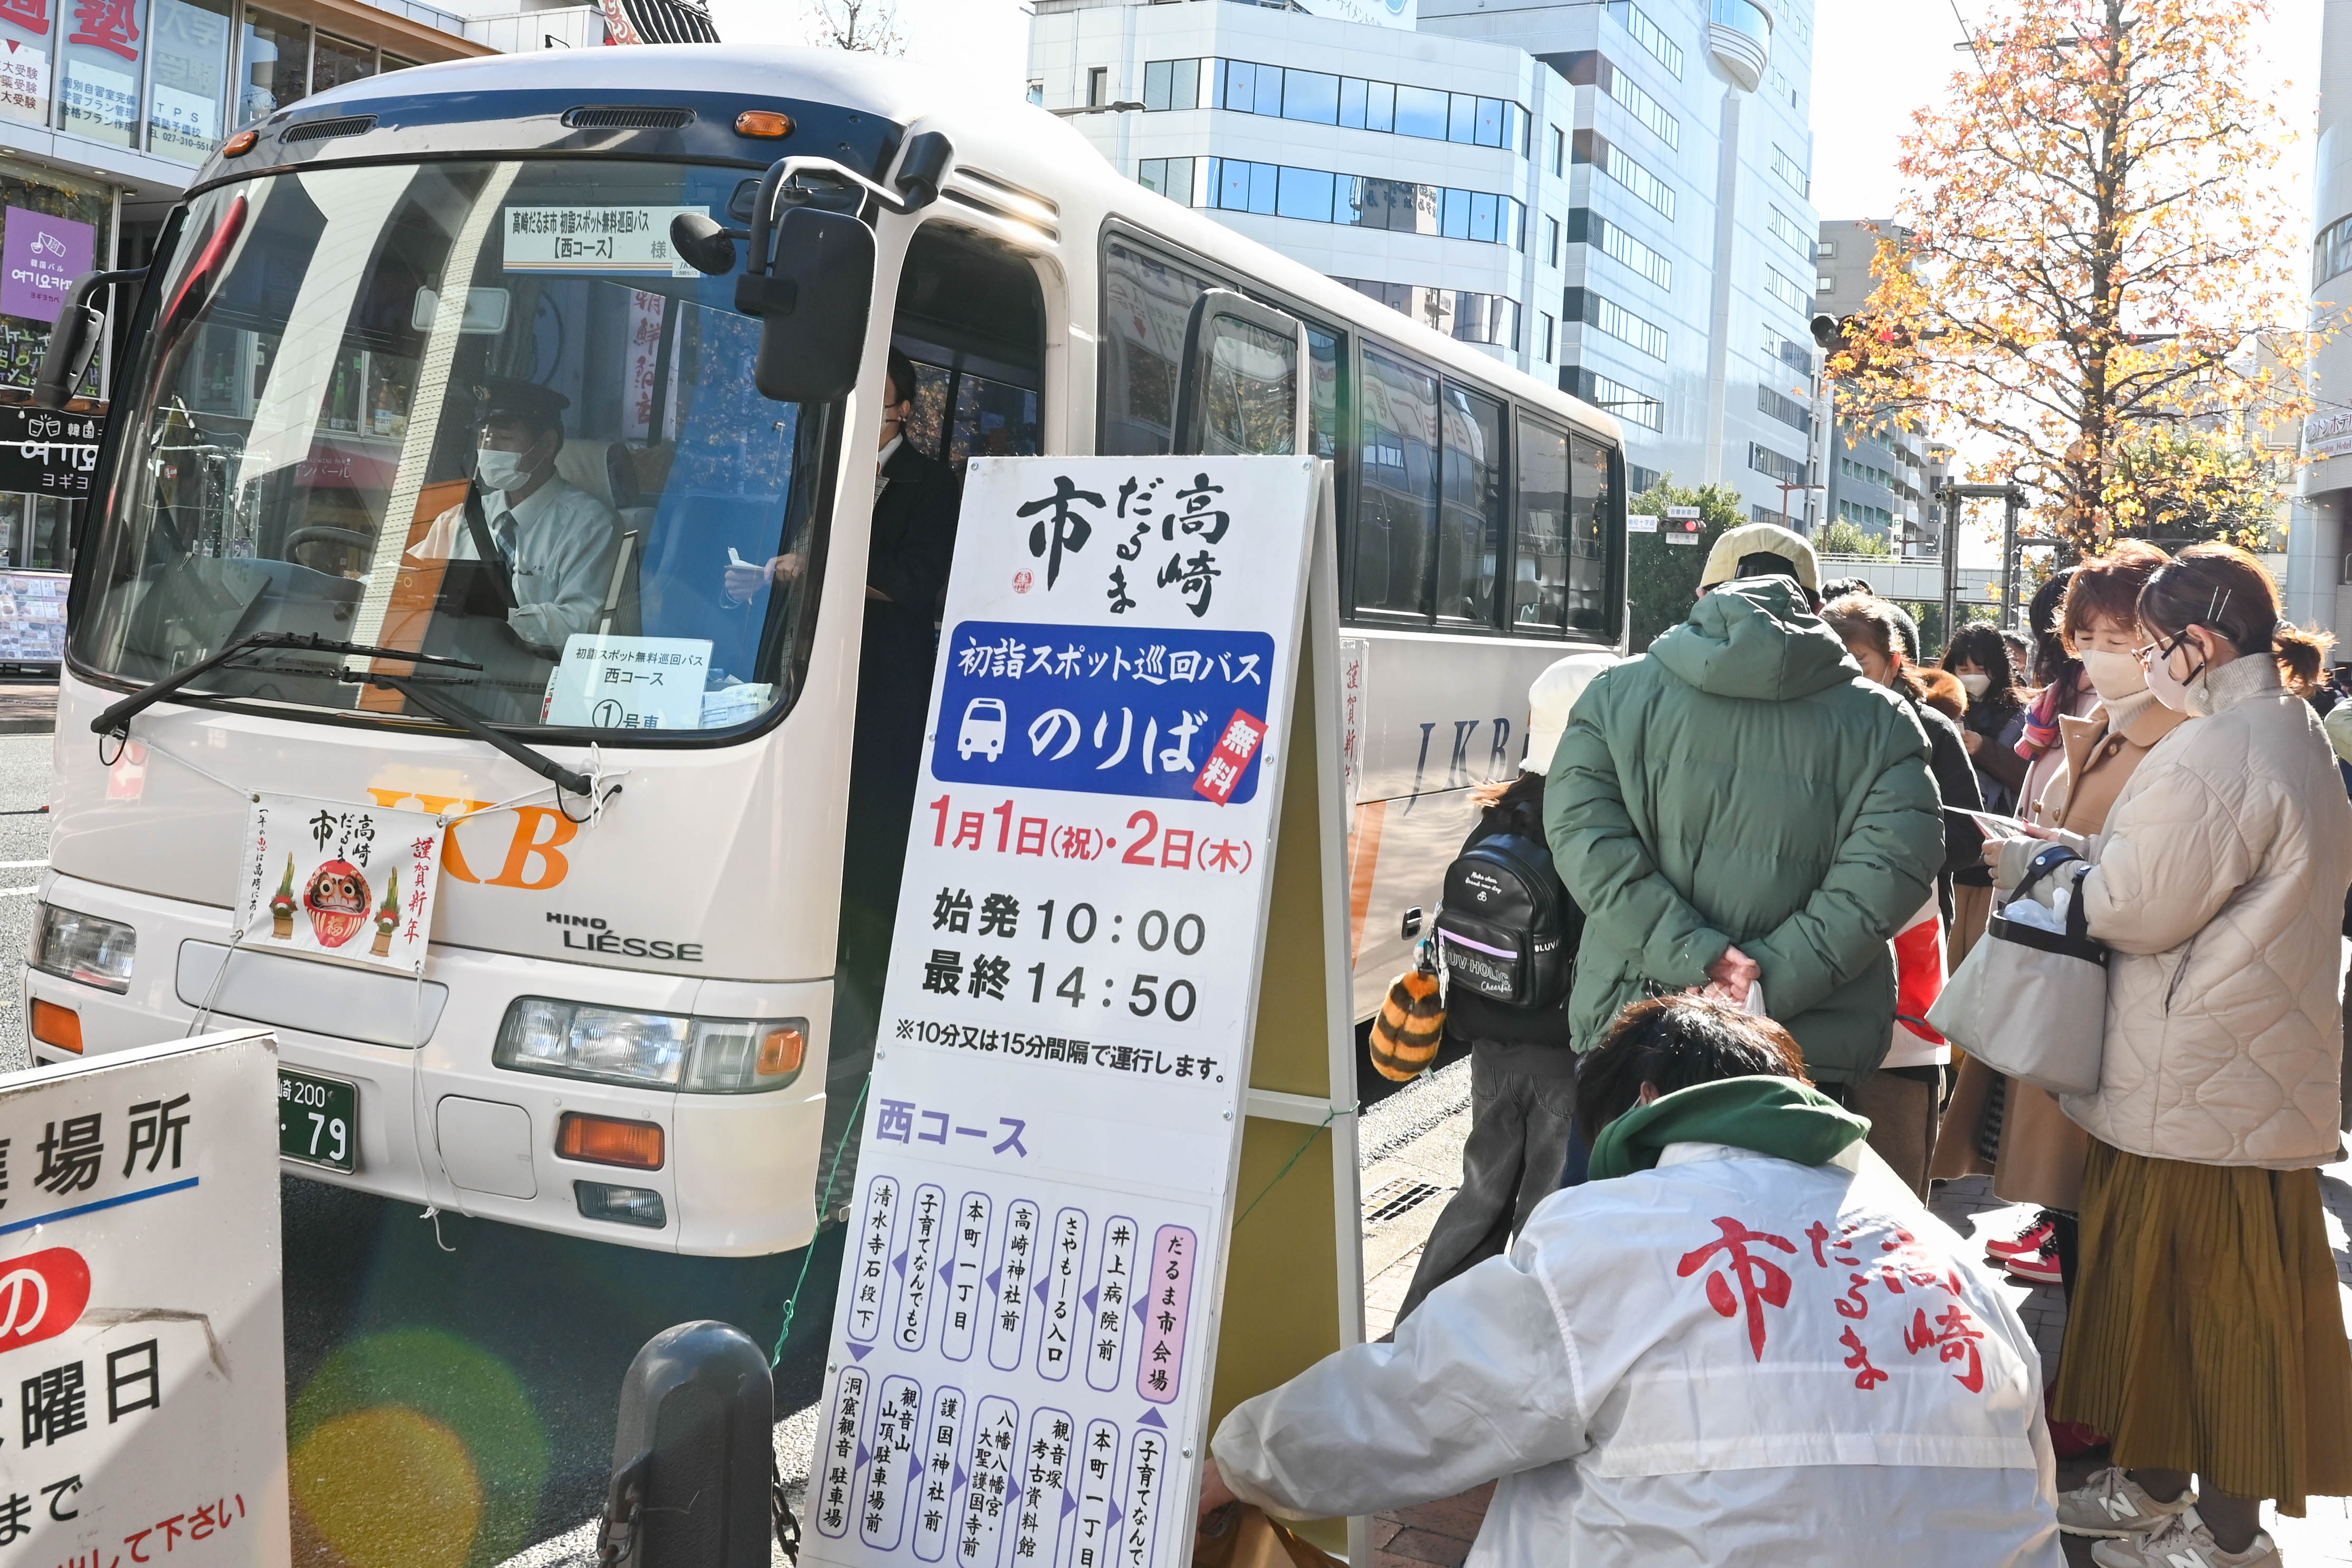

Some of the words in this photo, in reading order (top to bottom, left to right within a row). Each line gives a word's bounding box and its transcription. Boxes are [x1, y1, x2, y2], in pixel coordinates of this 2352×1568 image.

[0, 61, 39, 80] 大受験
[0, 74, 37, 95] 薬受験
[63, 77, 136, 105] 個別自習室完備
[60, 105, 135, 132] 合格プラン作成
[61, 90, 136, 120] 学習プラン管理
[513, 210, 557, 234] 高崎だるま市
[560, 210, 649, 234] 初詣スポット無料巡回バス
[651, 240, 666, 259] 様
[67, 423, 103, 439] 韓国
[576, 647, 703, 666] 初詣スポット無料巡回バス
[604, 668, 663, 686] 西コース
[958, 635, 1262, 685] 初詣スポット巡回バス
[1028, 707, 1208, 774] のりば
[1201, 719, 1257, 796] 無料
[1403, 717, 1530, 817] JKB
[404, 837, 435, 945] 謹賀新年
[546, 911, 607, 930] HINO
[933, 887, 1020, 938] 始発
[563, 929, 704, 962] LIÉSSE
[922, 949, 1011, 1001] 最終
[1446, 952, 1467, 970] UV
[1470, 960, 1509, 985] HOLIC
[1481, 981, 1513, 993] Cheerful
[0, 1092, 191, 1209] 場所
[876, 1099, 1028, 1158] 西コース
[857, 1184, 893, 1329] 清水寺石段下
[954, 1200, 984, 1331] 本町一丁目
[1000, 1208, 1032, 1332] 高崎神社前
[1047, 1217, 1077, 1362] さやもーる入口
[1097, 1225, 1130, 1362] 井上病院前
[1148, 1235, 1183, 1392] だるま市会場
[0, 1338, 159, 1449] 曜日
[924, 1398, 958, 1533] 護国神社前
[1045, 1419, 1069, 1489] 観音塚
[962, 1427, 993, 1558] 大聖護国寺前
[1017, 1438, 1049, 1558] 考古資料館
[1080, 1428, 1111, 1568] 本町一丁目
[1129, 1440, 1158, 1568] 子育てなんで
